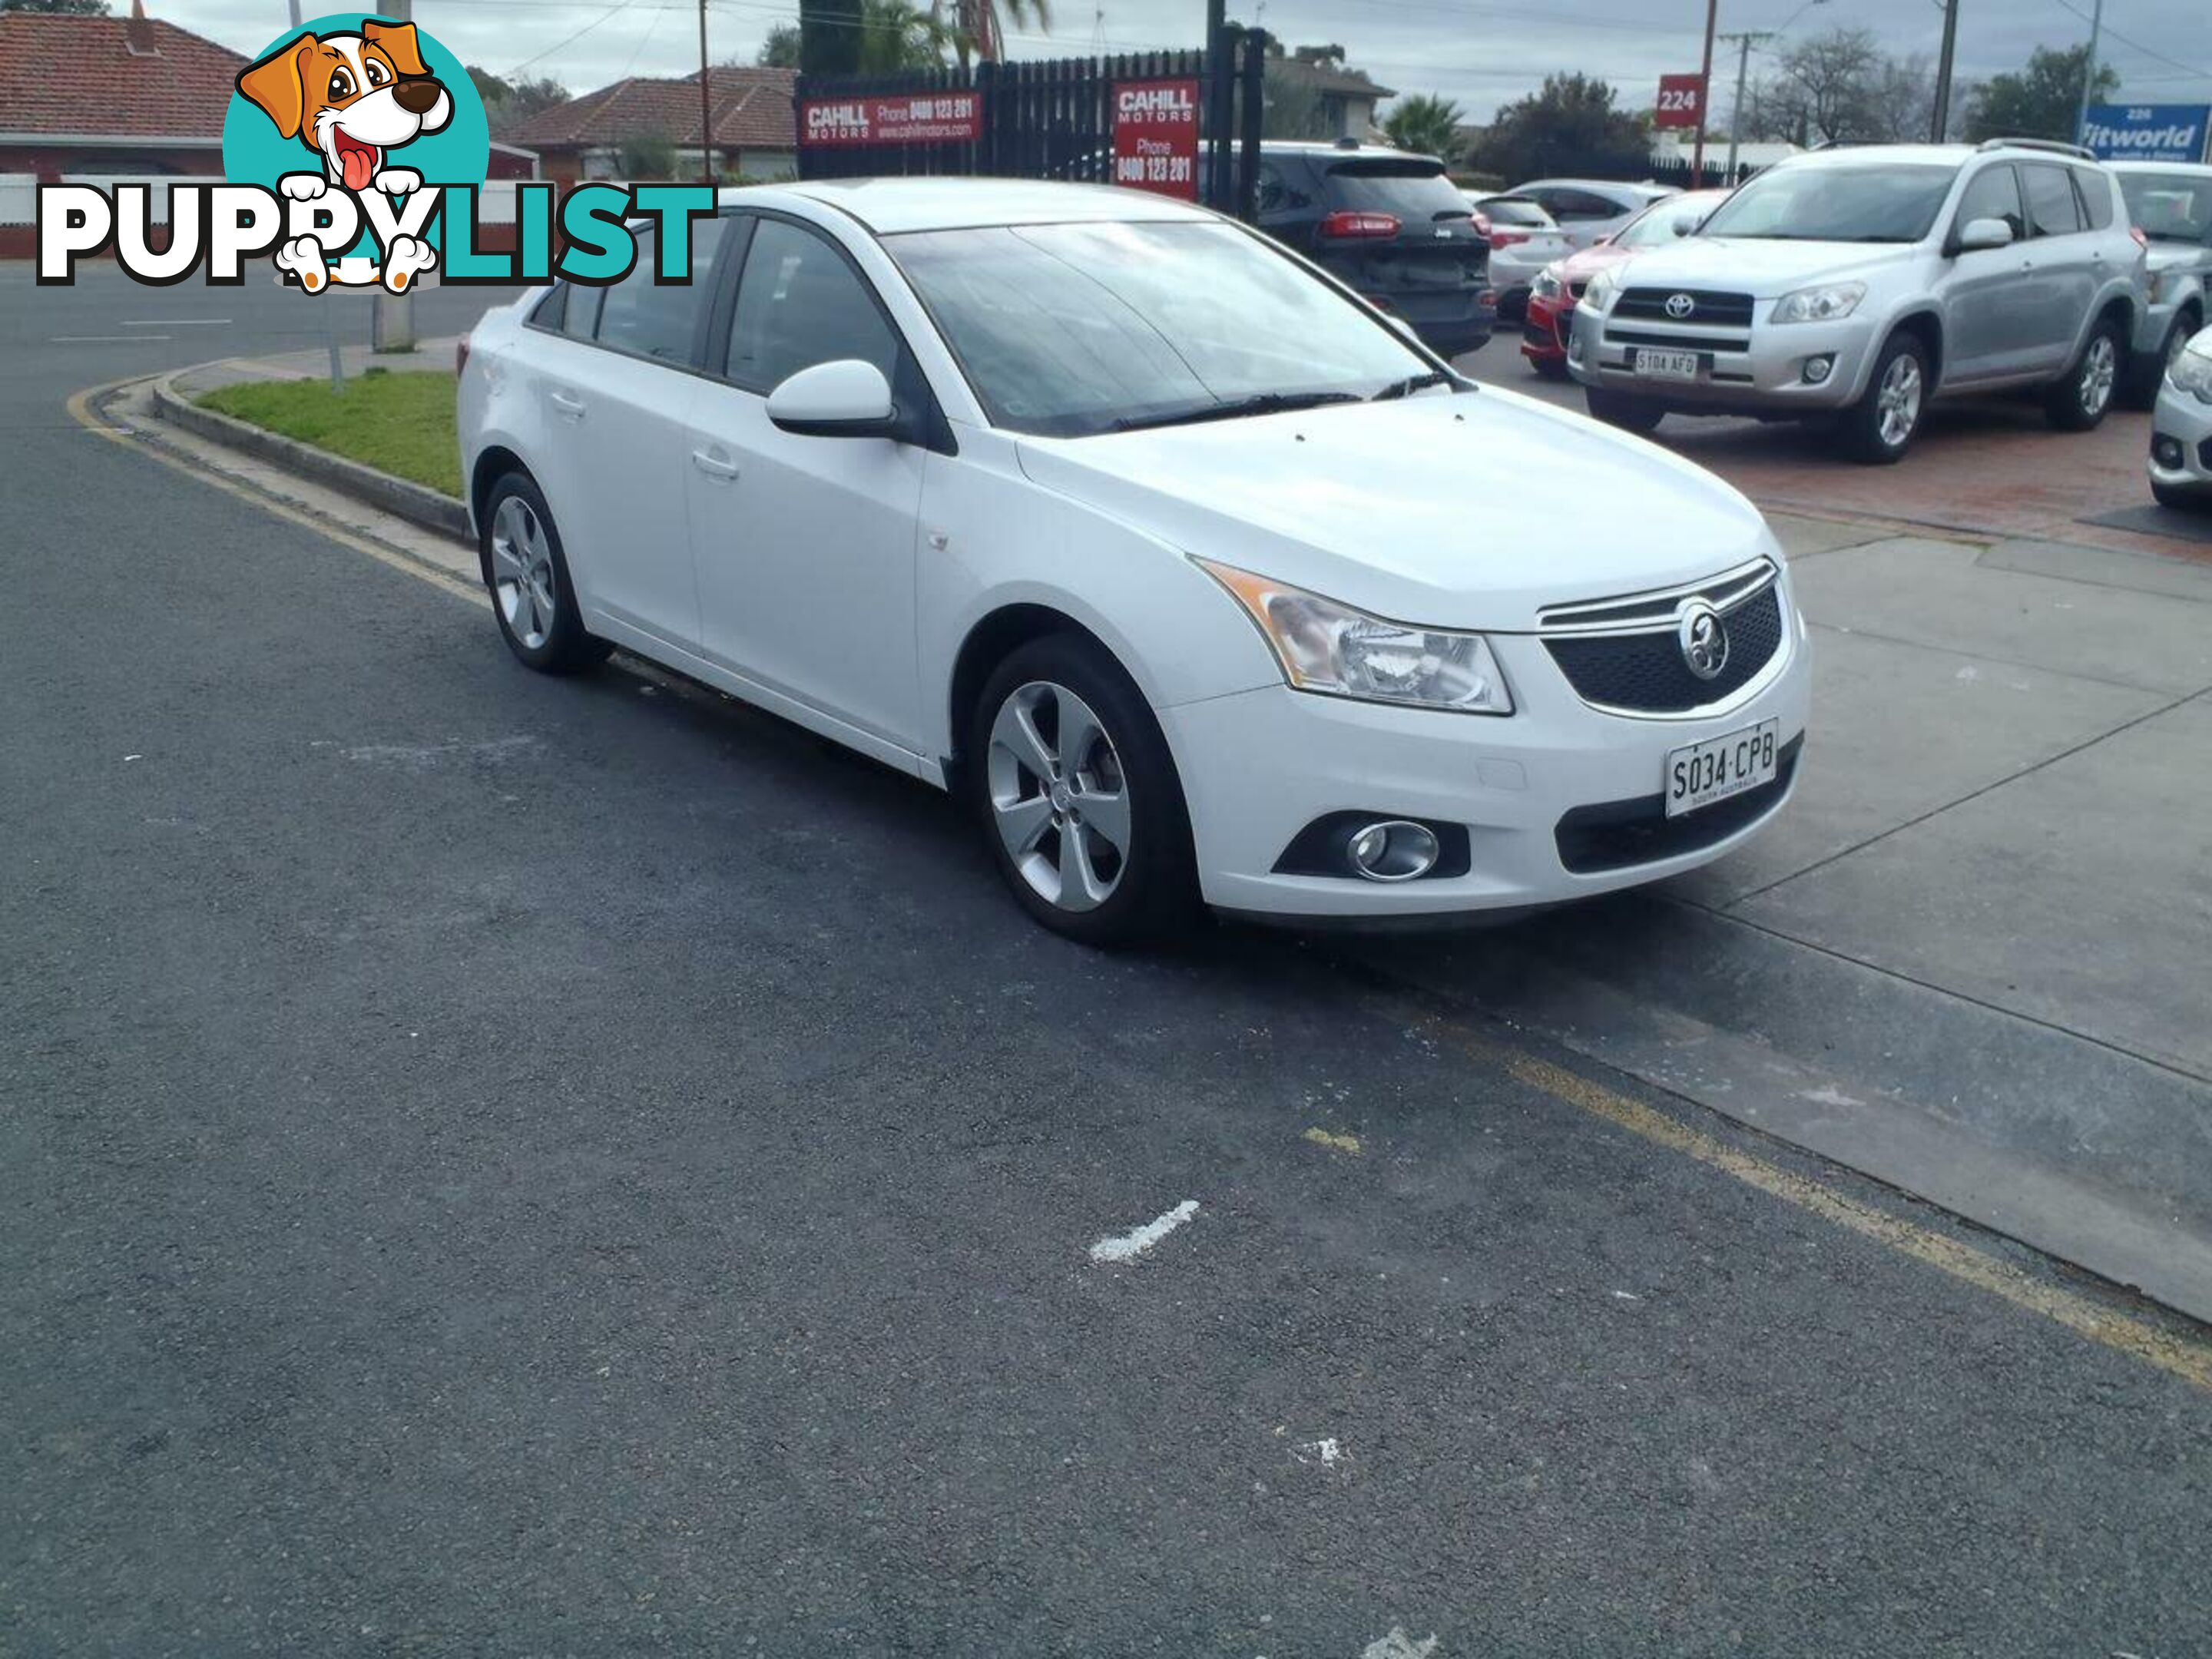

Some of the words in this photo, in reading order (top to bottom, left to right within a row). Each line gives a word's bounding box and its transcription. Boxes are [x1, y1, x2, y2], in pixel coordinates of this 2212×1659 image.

[877, 104, 908, 123] Phone
[934, 98, 954, 119] 123
[1119, 88, 1194, 111] CAHILL
[1660, 90, 1696, 111] 224
[808, 104, 869, 127] CAHILL
[1118, 110, 1192, 123] MOTORS
[808, 125, 869, 140] MOTORS
[1137, 137, 1171, 155] Phone
[1147, 156, 1168, 181] 123
